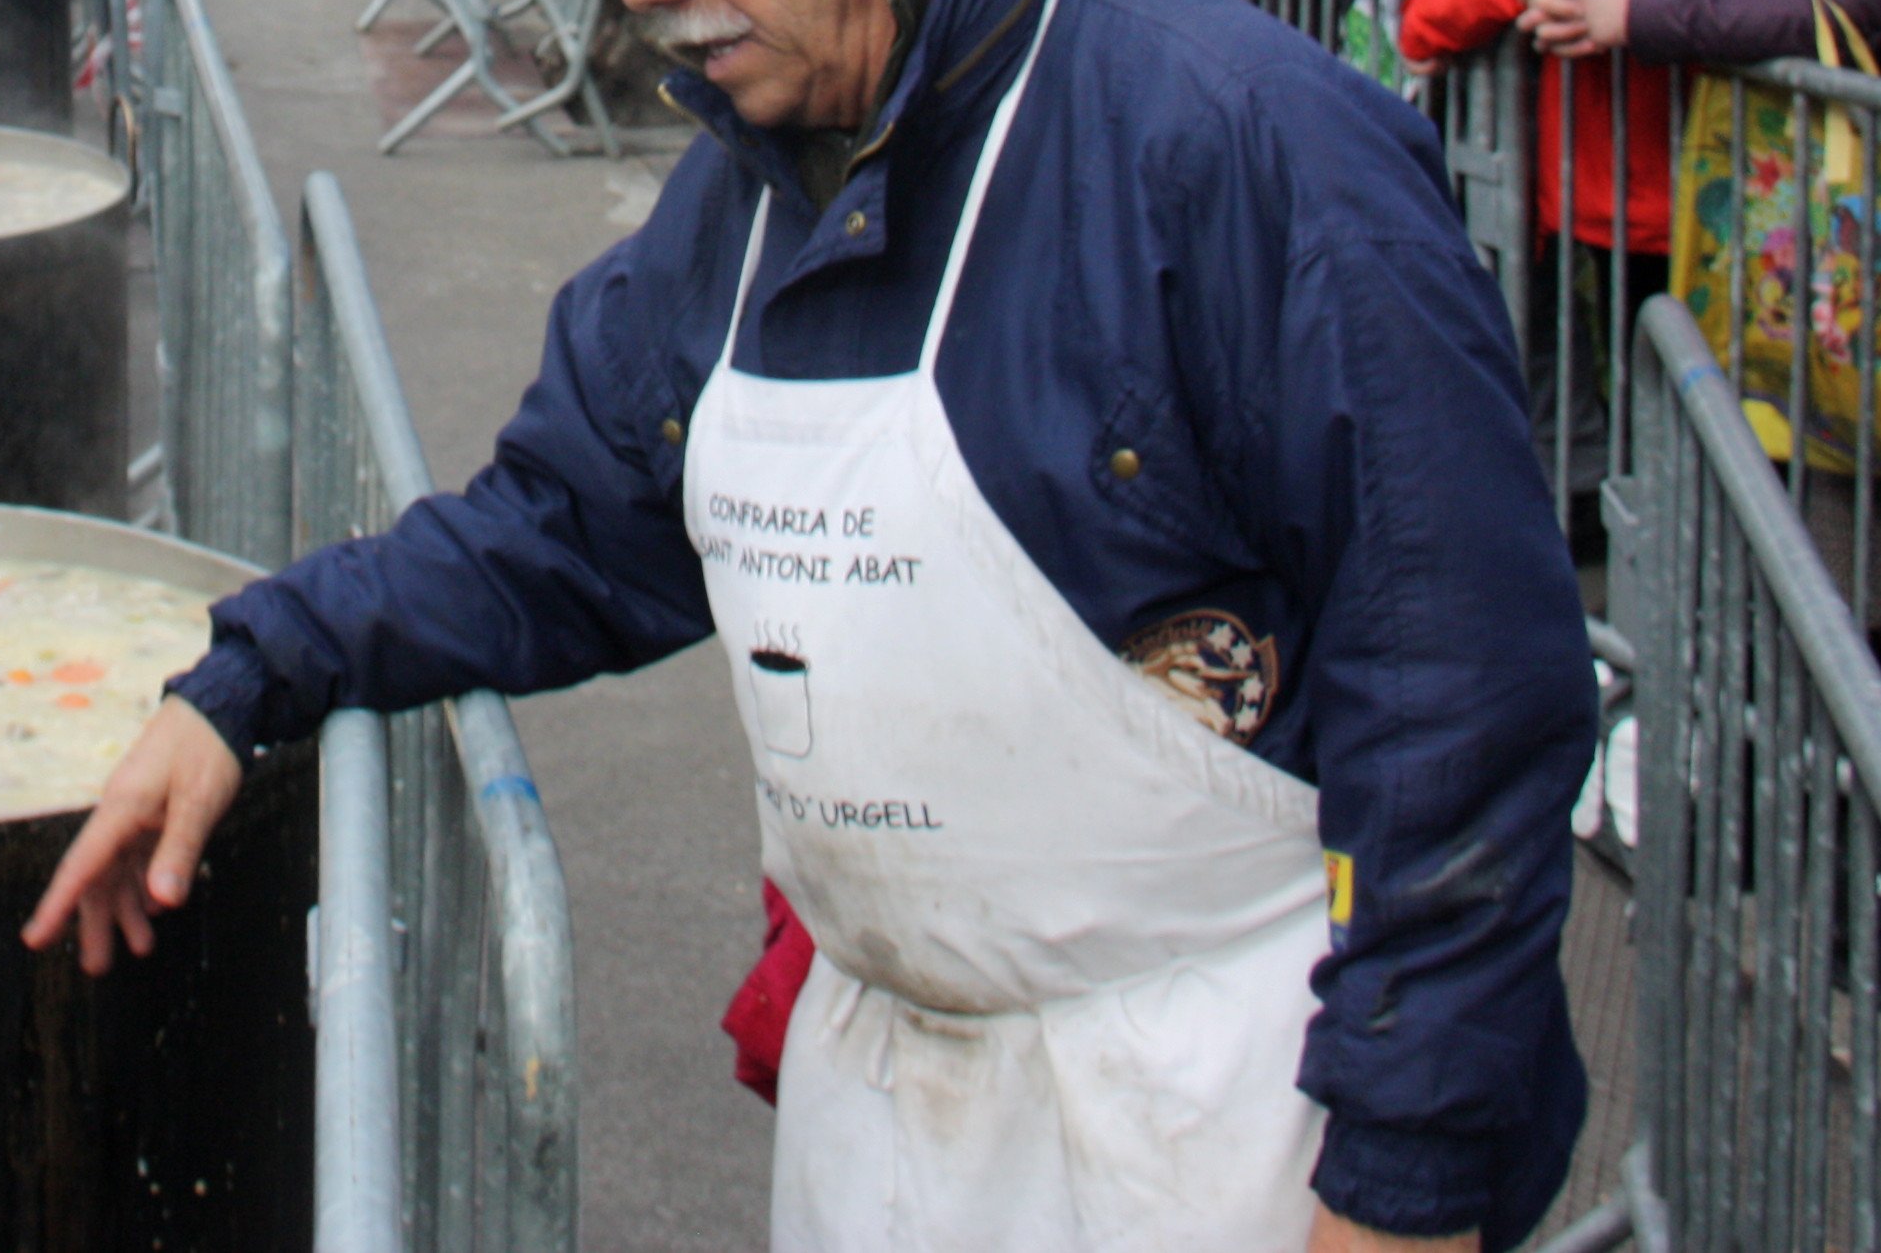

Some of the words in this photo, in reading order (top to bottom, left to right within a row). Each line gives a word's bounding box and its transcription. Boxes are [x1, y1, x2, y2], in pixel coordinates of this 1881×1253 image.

[708, 492, 828, 537] CONFRARIA
[842, 507, 875, 537] DE
[698, 535, 732, 564] SANT
[738, 545, 831, 583] ANTONI
[844, 554, 922, 585] ABAT
